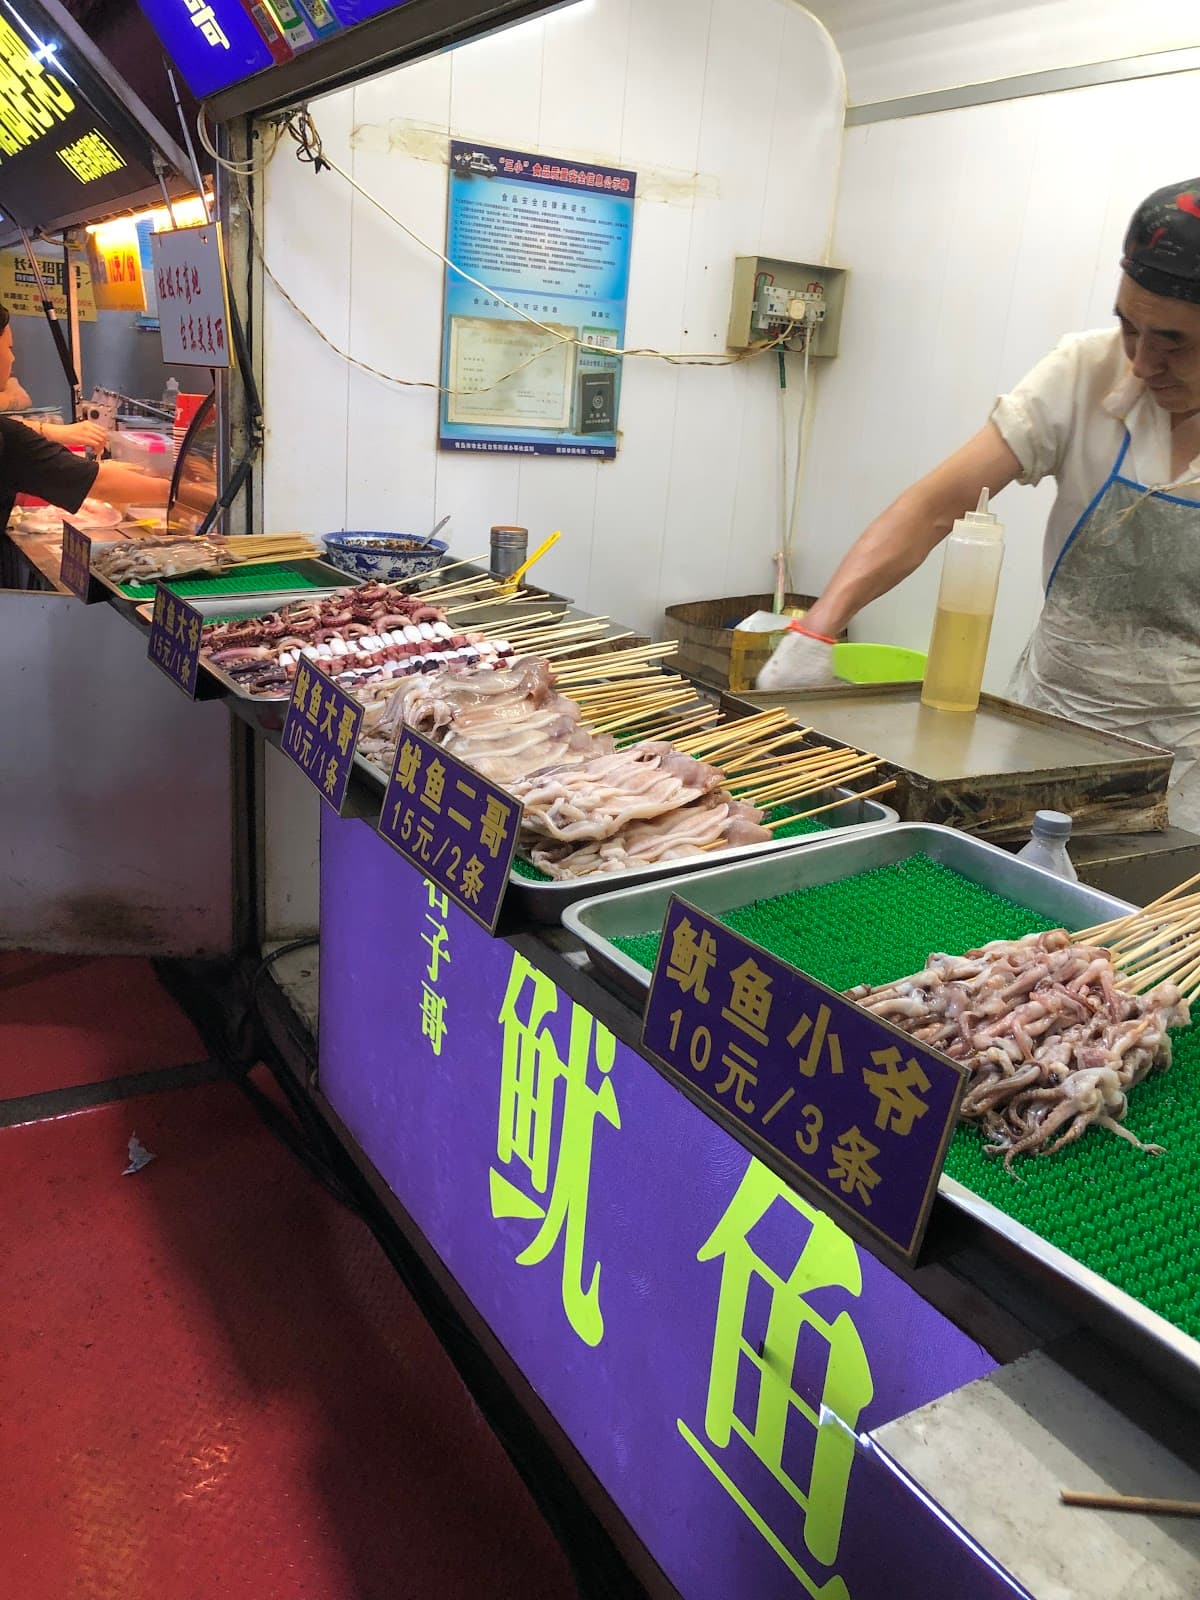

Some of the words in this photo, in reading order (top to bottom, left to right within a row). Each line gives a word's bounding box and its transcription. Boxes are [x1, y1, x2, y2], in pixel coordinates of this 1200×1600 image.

[152, 632, 192, 686] 15元/1条
[292, 666, 357, 756] 鱿鱼大哥
[287, 719, 340, 797] 10元/1条
[395, 738, 511, 858] 鱿鱼二哥
[391, 800, 486, 905] 15元/2条
[666, 916, 933, 1136] 鱿鱼小爷
[669, 1008, 883, 1207] 10元/3条
